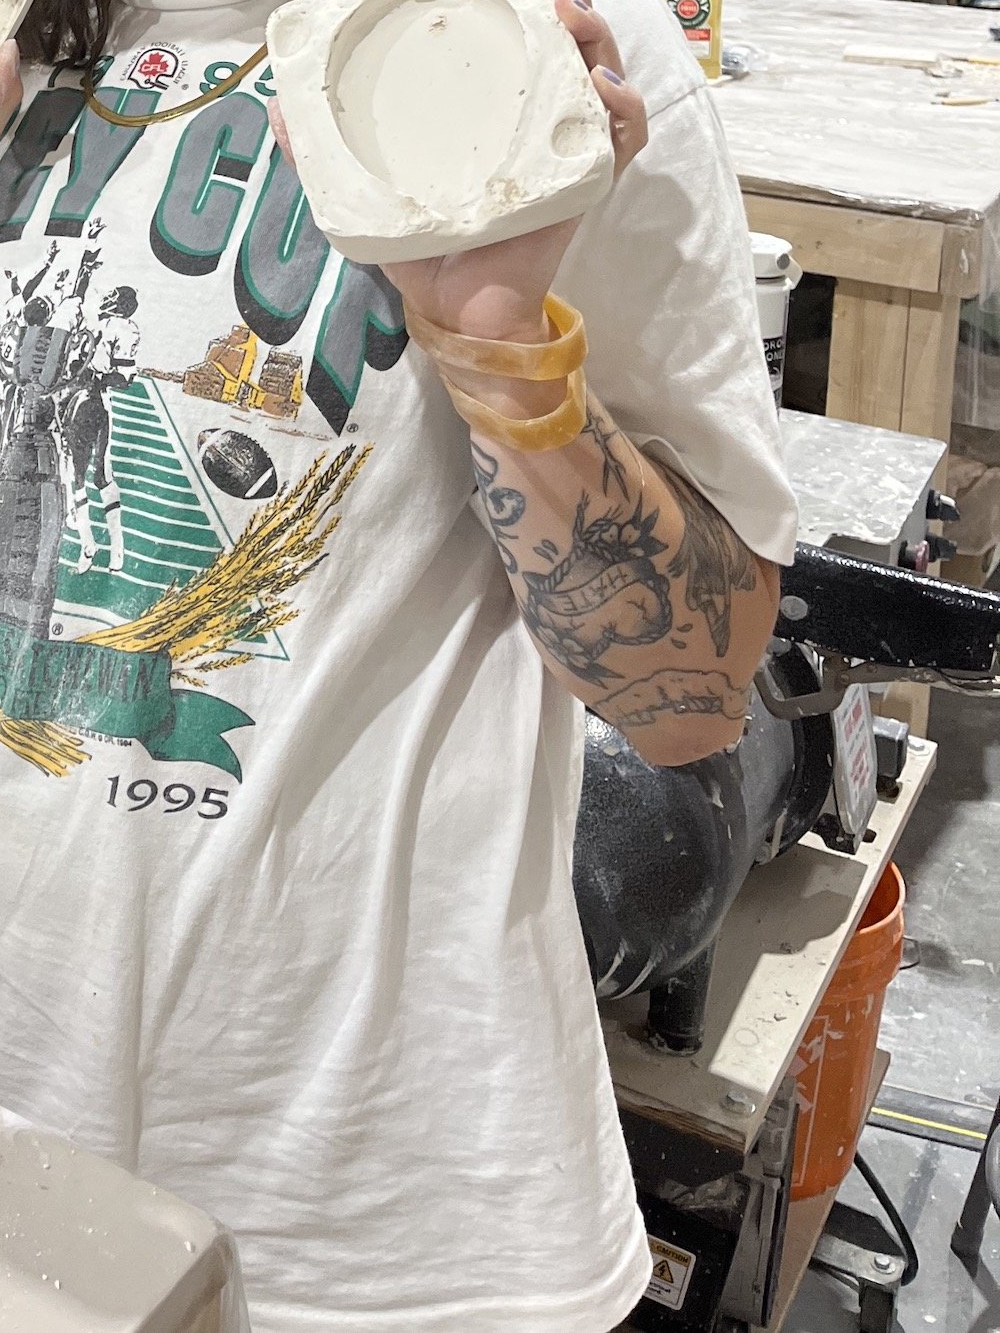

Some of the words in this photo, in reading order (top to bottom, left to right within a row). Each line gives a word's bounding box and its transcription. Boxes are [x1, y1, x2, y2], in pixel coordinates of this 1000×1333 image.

[141, 63, 165, 72] CFL
[557, 567, 628, 611] HATE
[107, 775, 229, 820] 1995
[656, 1245, 689, 1264] CAUTION
